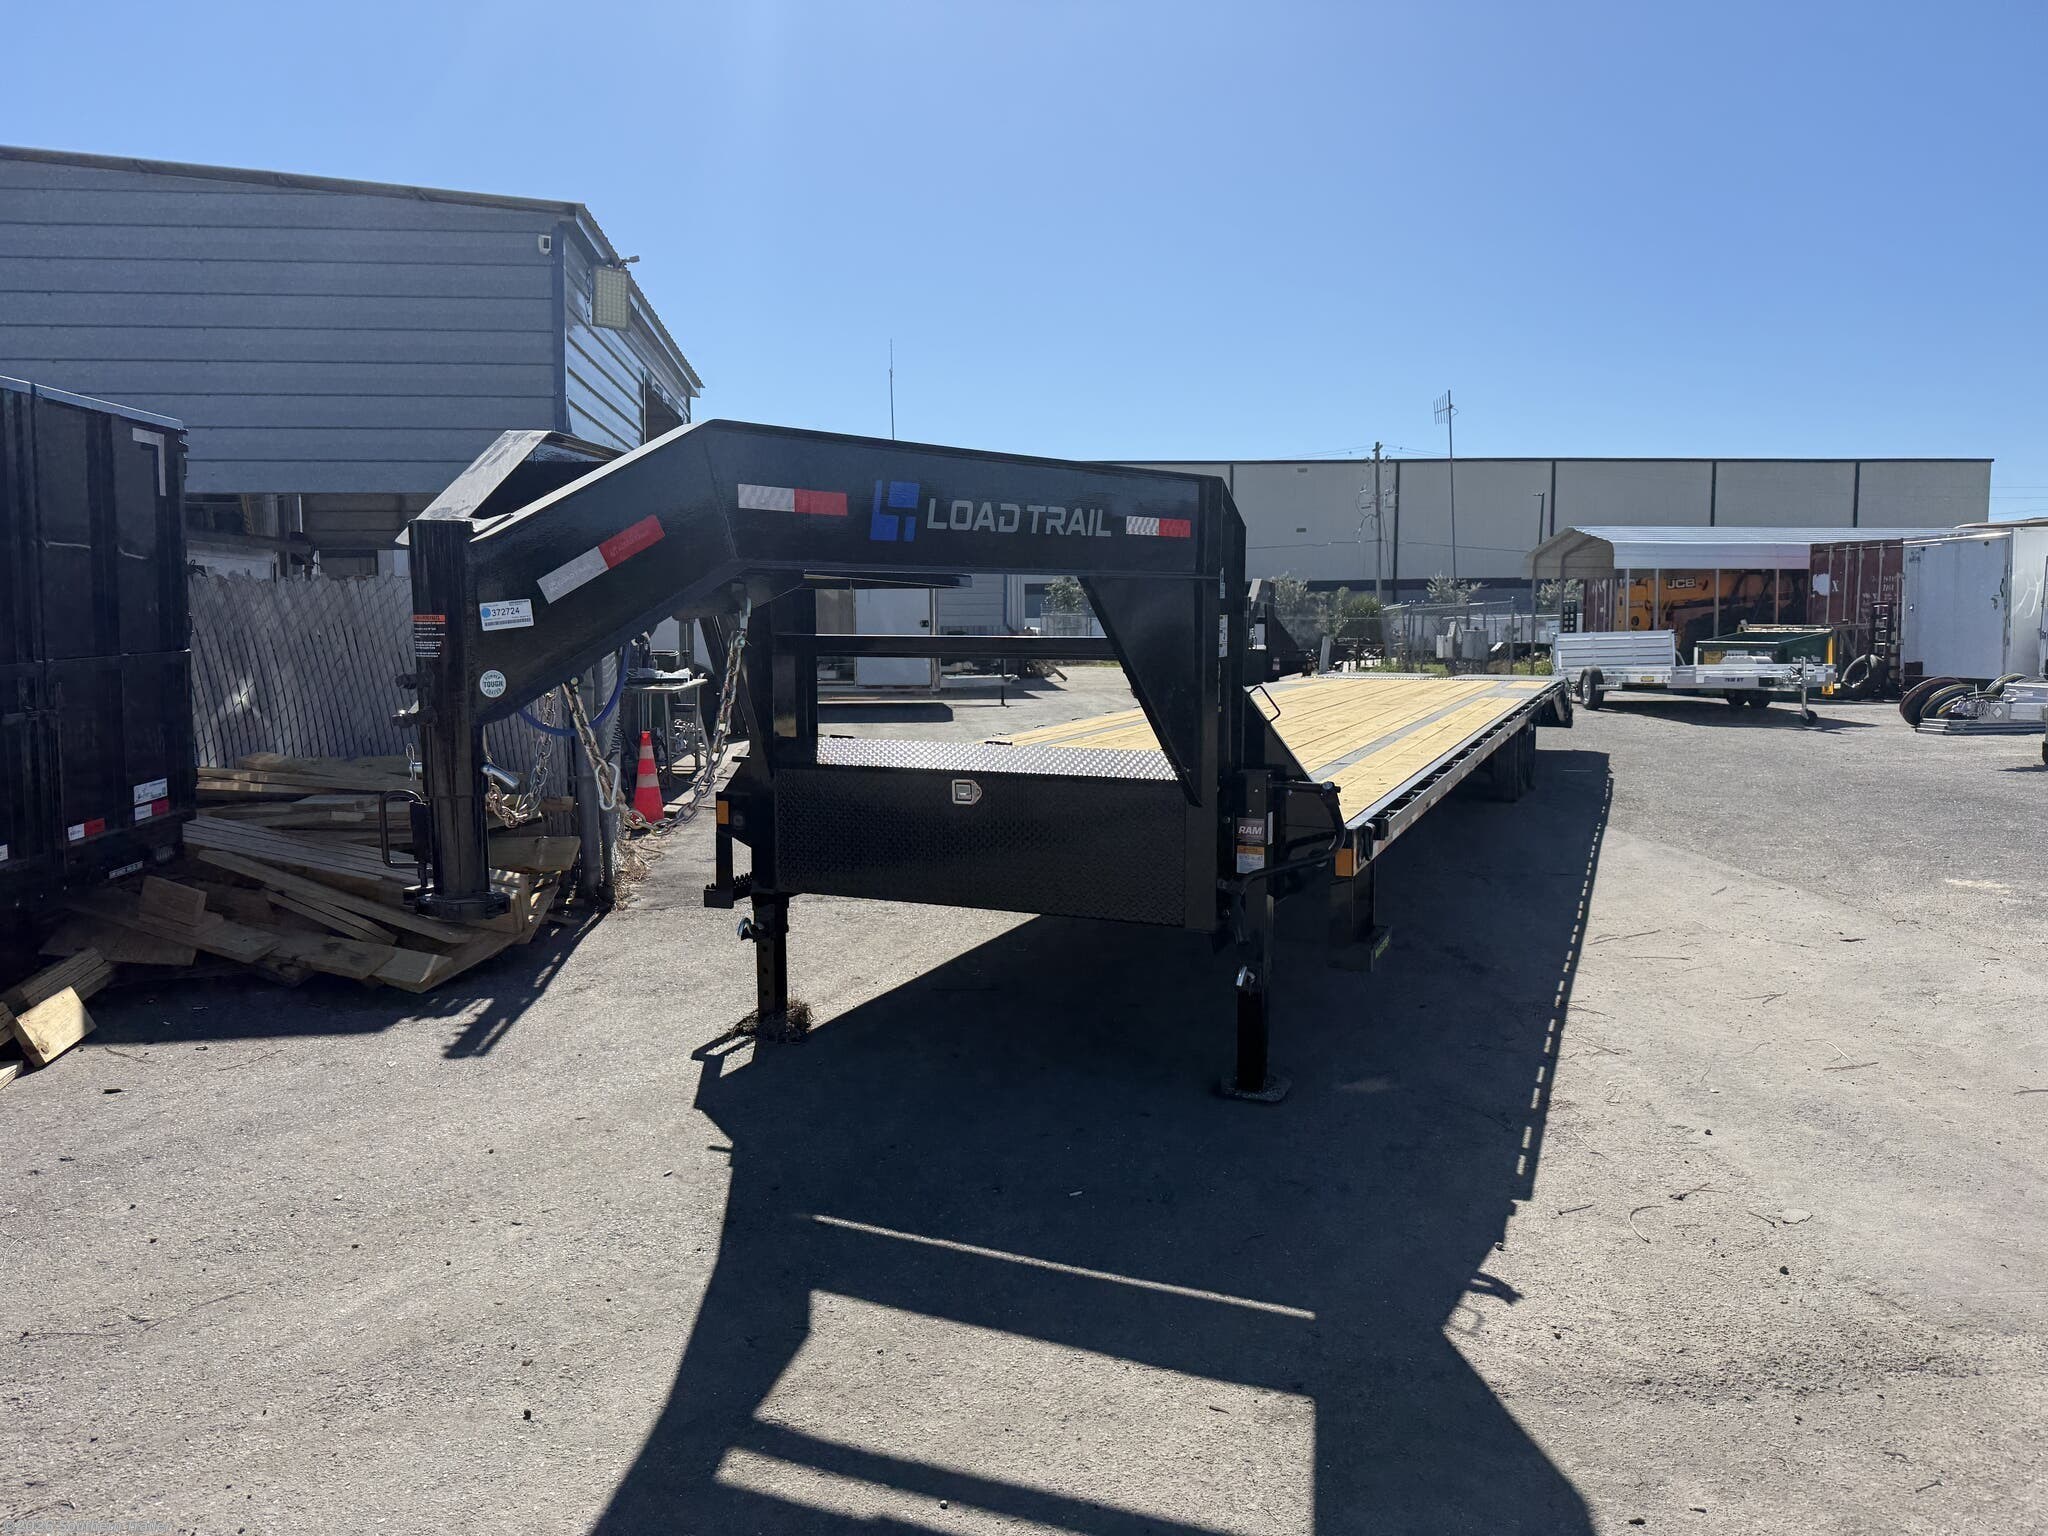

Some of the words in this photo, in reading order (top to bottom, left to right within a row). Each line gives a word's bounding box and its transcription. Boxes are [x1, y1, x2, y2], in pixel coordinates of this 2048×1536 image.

[927, 498, 1020, 533] LOAD
[1027, 505, 1111, 537] TRAIL
[1667, 579, 1696, 589] JCB
[491, 607, 520, 617] 372724
[1238, 826, 1263, 835] RAM
